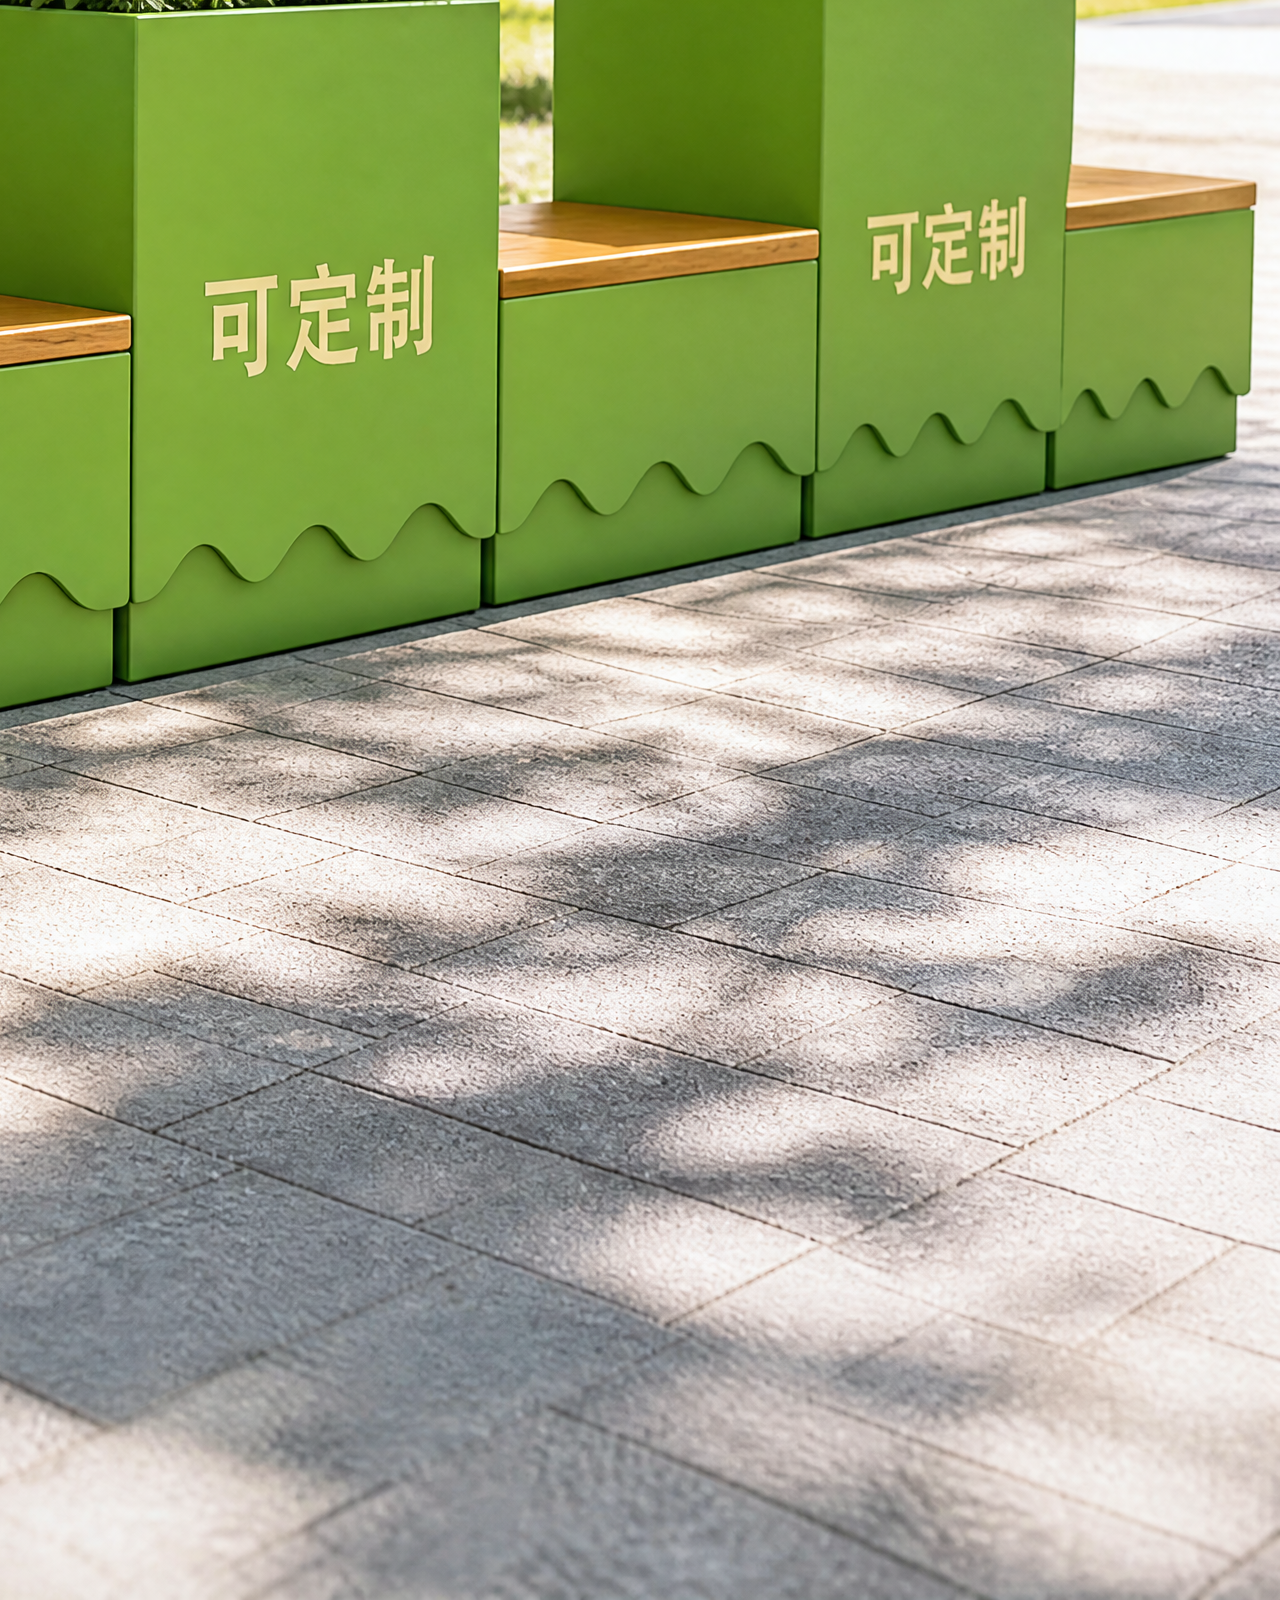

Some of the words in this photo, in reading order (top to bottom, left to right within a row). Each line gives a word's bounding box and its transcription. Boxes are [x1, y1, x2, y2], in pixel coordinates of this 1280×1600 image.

[866, 195, 1027, 295] 可定制
[203, 253, 436, 378] 可定制
